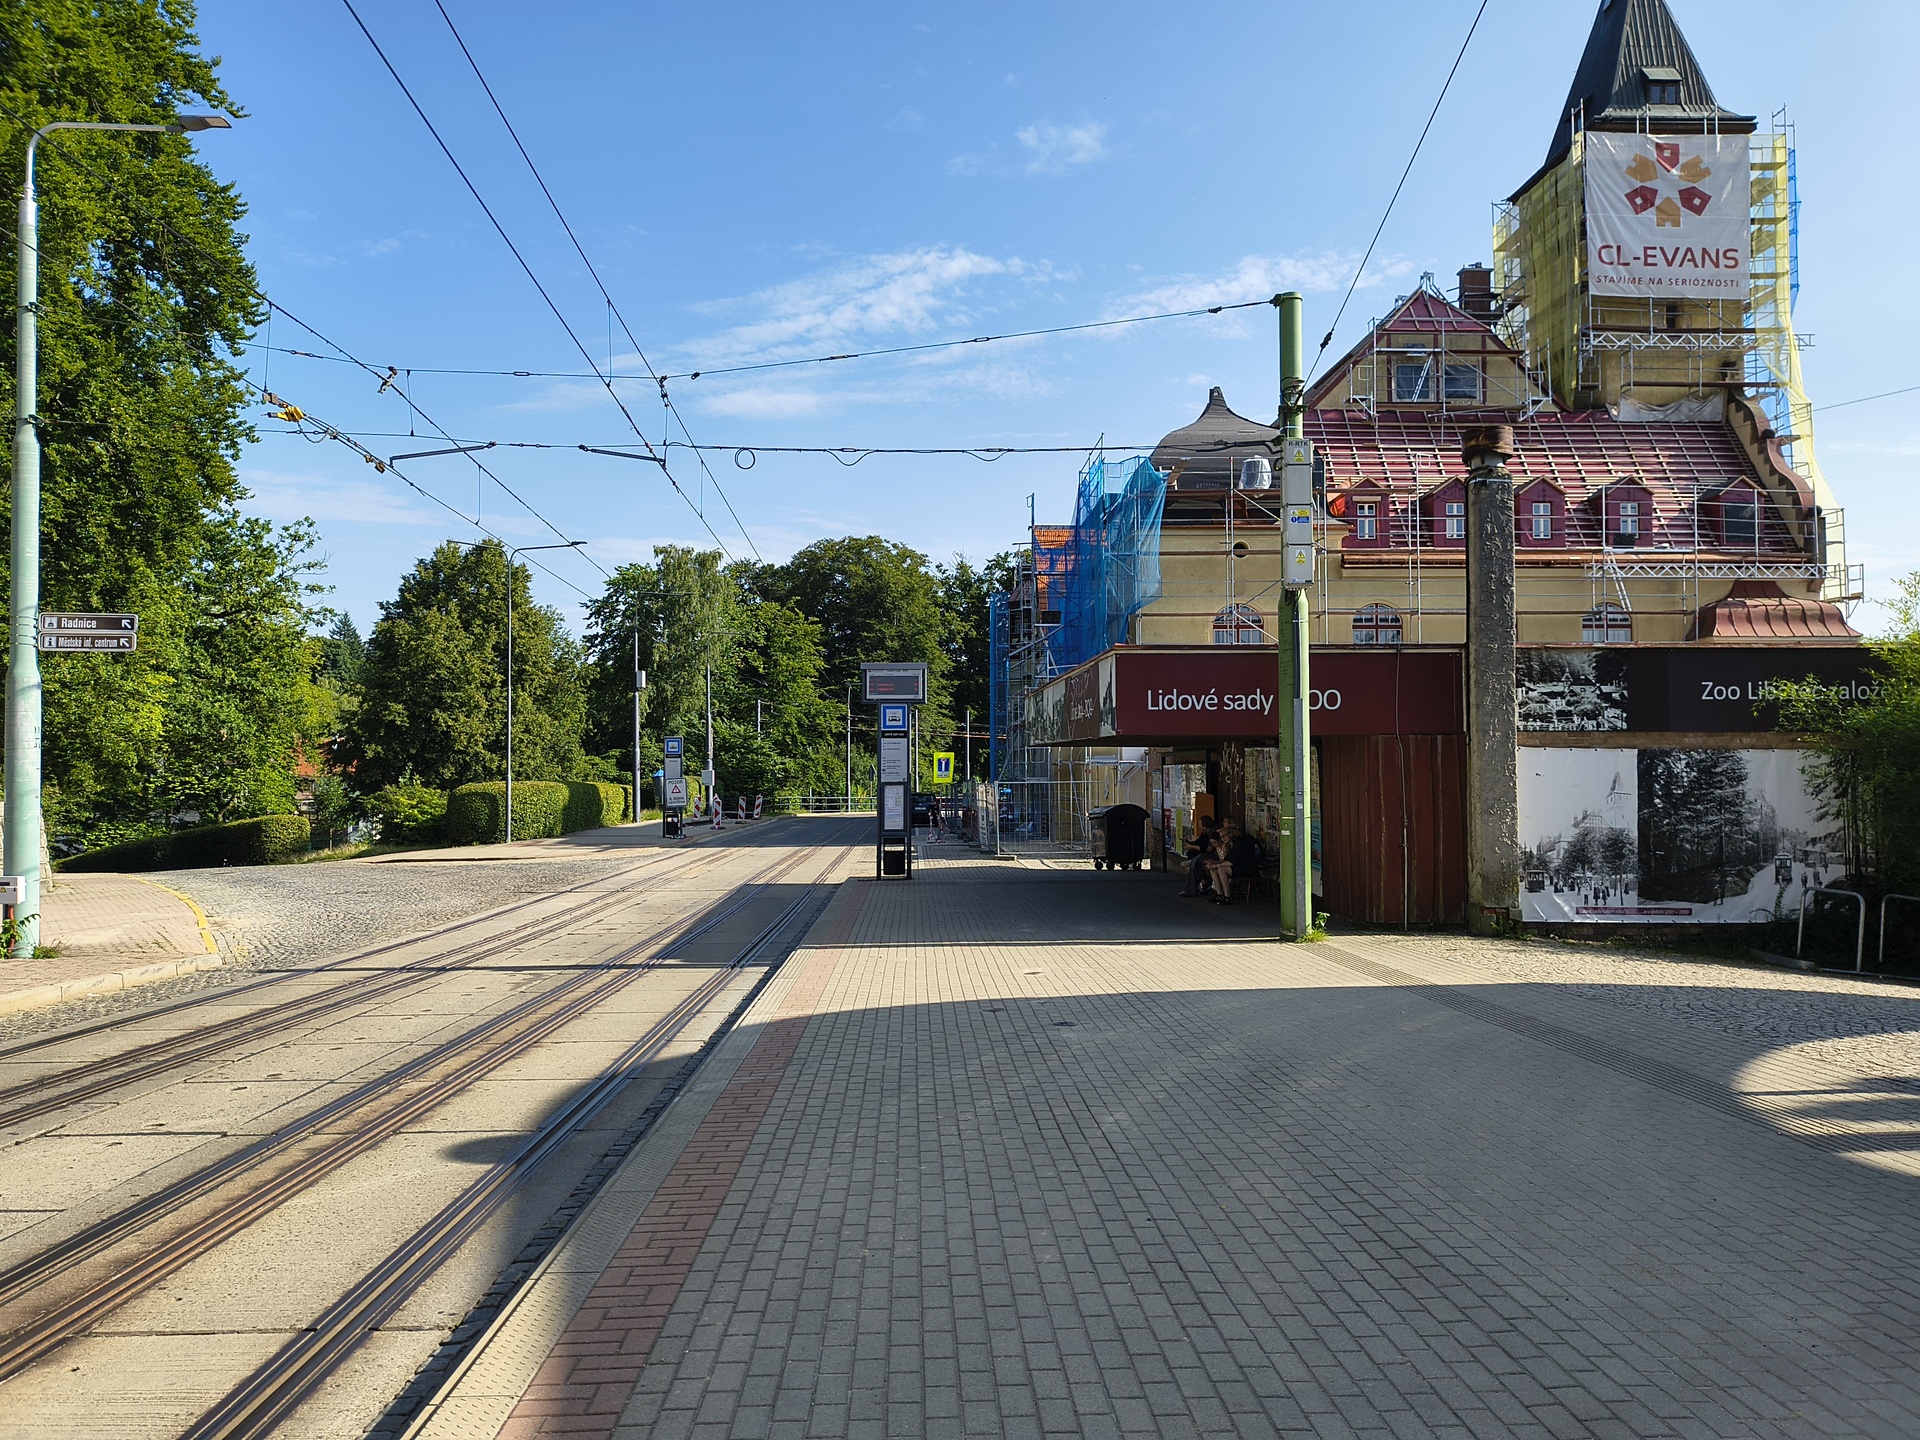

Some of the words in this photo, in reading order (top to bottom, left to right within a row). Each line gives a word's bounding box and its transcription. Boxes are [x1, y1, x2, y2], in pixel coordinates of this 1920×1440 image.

[1597, 245, 1739, 269] CL-EVANS
[1596, 275, 1643, 285] STAVÍME
[1648, 277, 1663, 285] NA
[1668, 277, 1739, 287] SERIÓZNOSTI
[61, 618, 97, 629] Radnice
[58, 637, 82, 647] Městské
[95, 637, 118, 647] centrum
[1701, 681, 1740, 700] Zoo
[1147, 688, 1218, 711] Lidové
[1223, 688, 1274, 715] sady
[1308, 689, 1342, 710] OO
